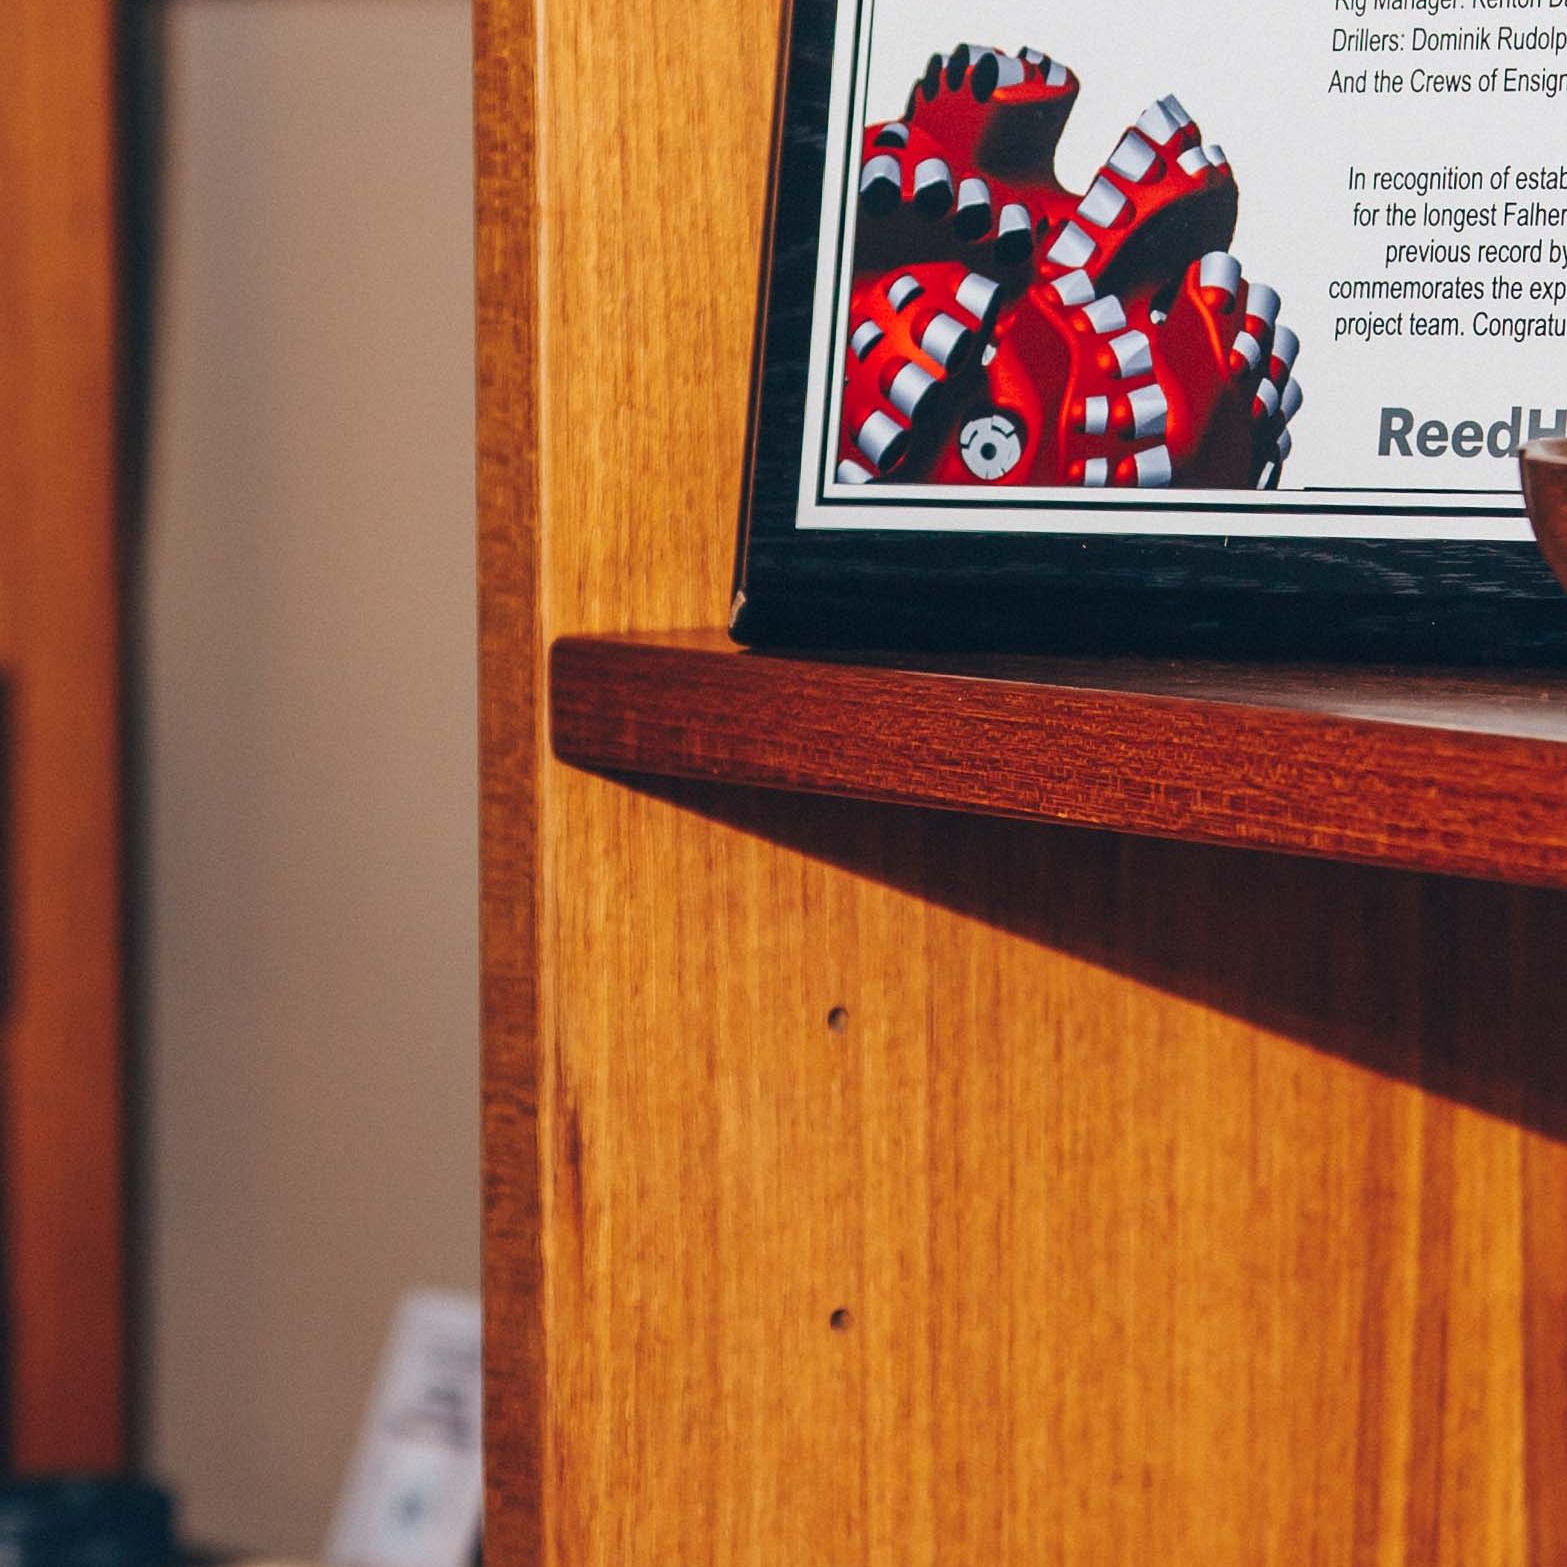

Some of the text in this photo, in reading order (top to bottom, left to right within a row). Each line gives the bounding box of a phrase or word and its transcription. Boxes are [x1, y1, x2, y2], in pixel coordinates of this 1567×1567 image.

[1331, 27, 1406, 53] Drillers:
[1410, 25, 1491, 53] Dominik
[1326, 68, 1368, 95] And
[1373, 68, 1405, 94] the
[1409, 67, 1473, 94] Crews
[1477, 67, 1500, 94] of
[1347, 165, 1367, 191] In
[1372, 164, 1484, 197] recognition
[1489, 164, 1512, 191] of
[1352, 201, 1381, 228] for
[1385, 202, 1418, 228] the
[1422, 201, 1498, 234] longest
[1384, 237, 1472, 270] previous
[1476, 237, 1544, 264] record
[1327, 275, 1485, 301] commemorates
[1490, 274, 1524, 301] the
[1333, 310, 1404, 343] project
[1408, 311, 1465, 337] team.
